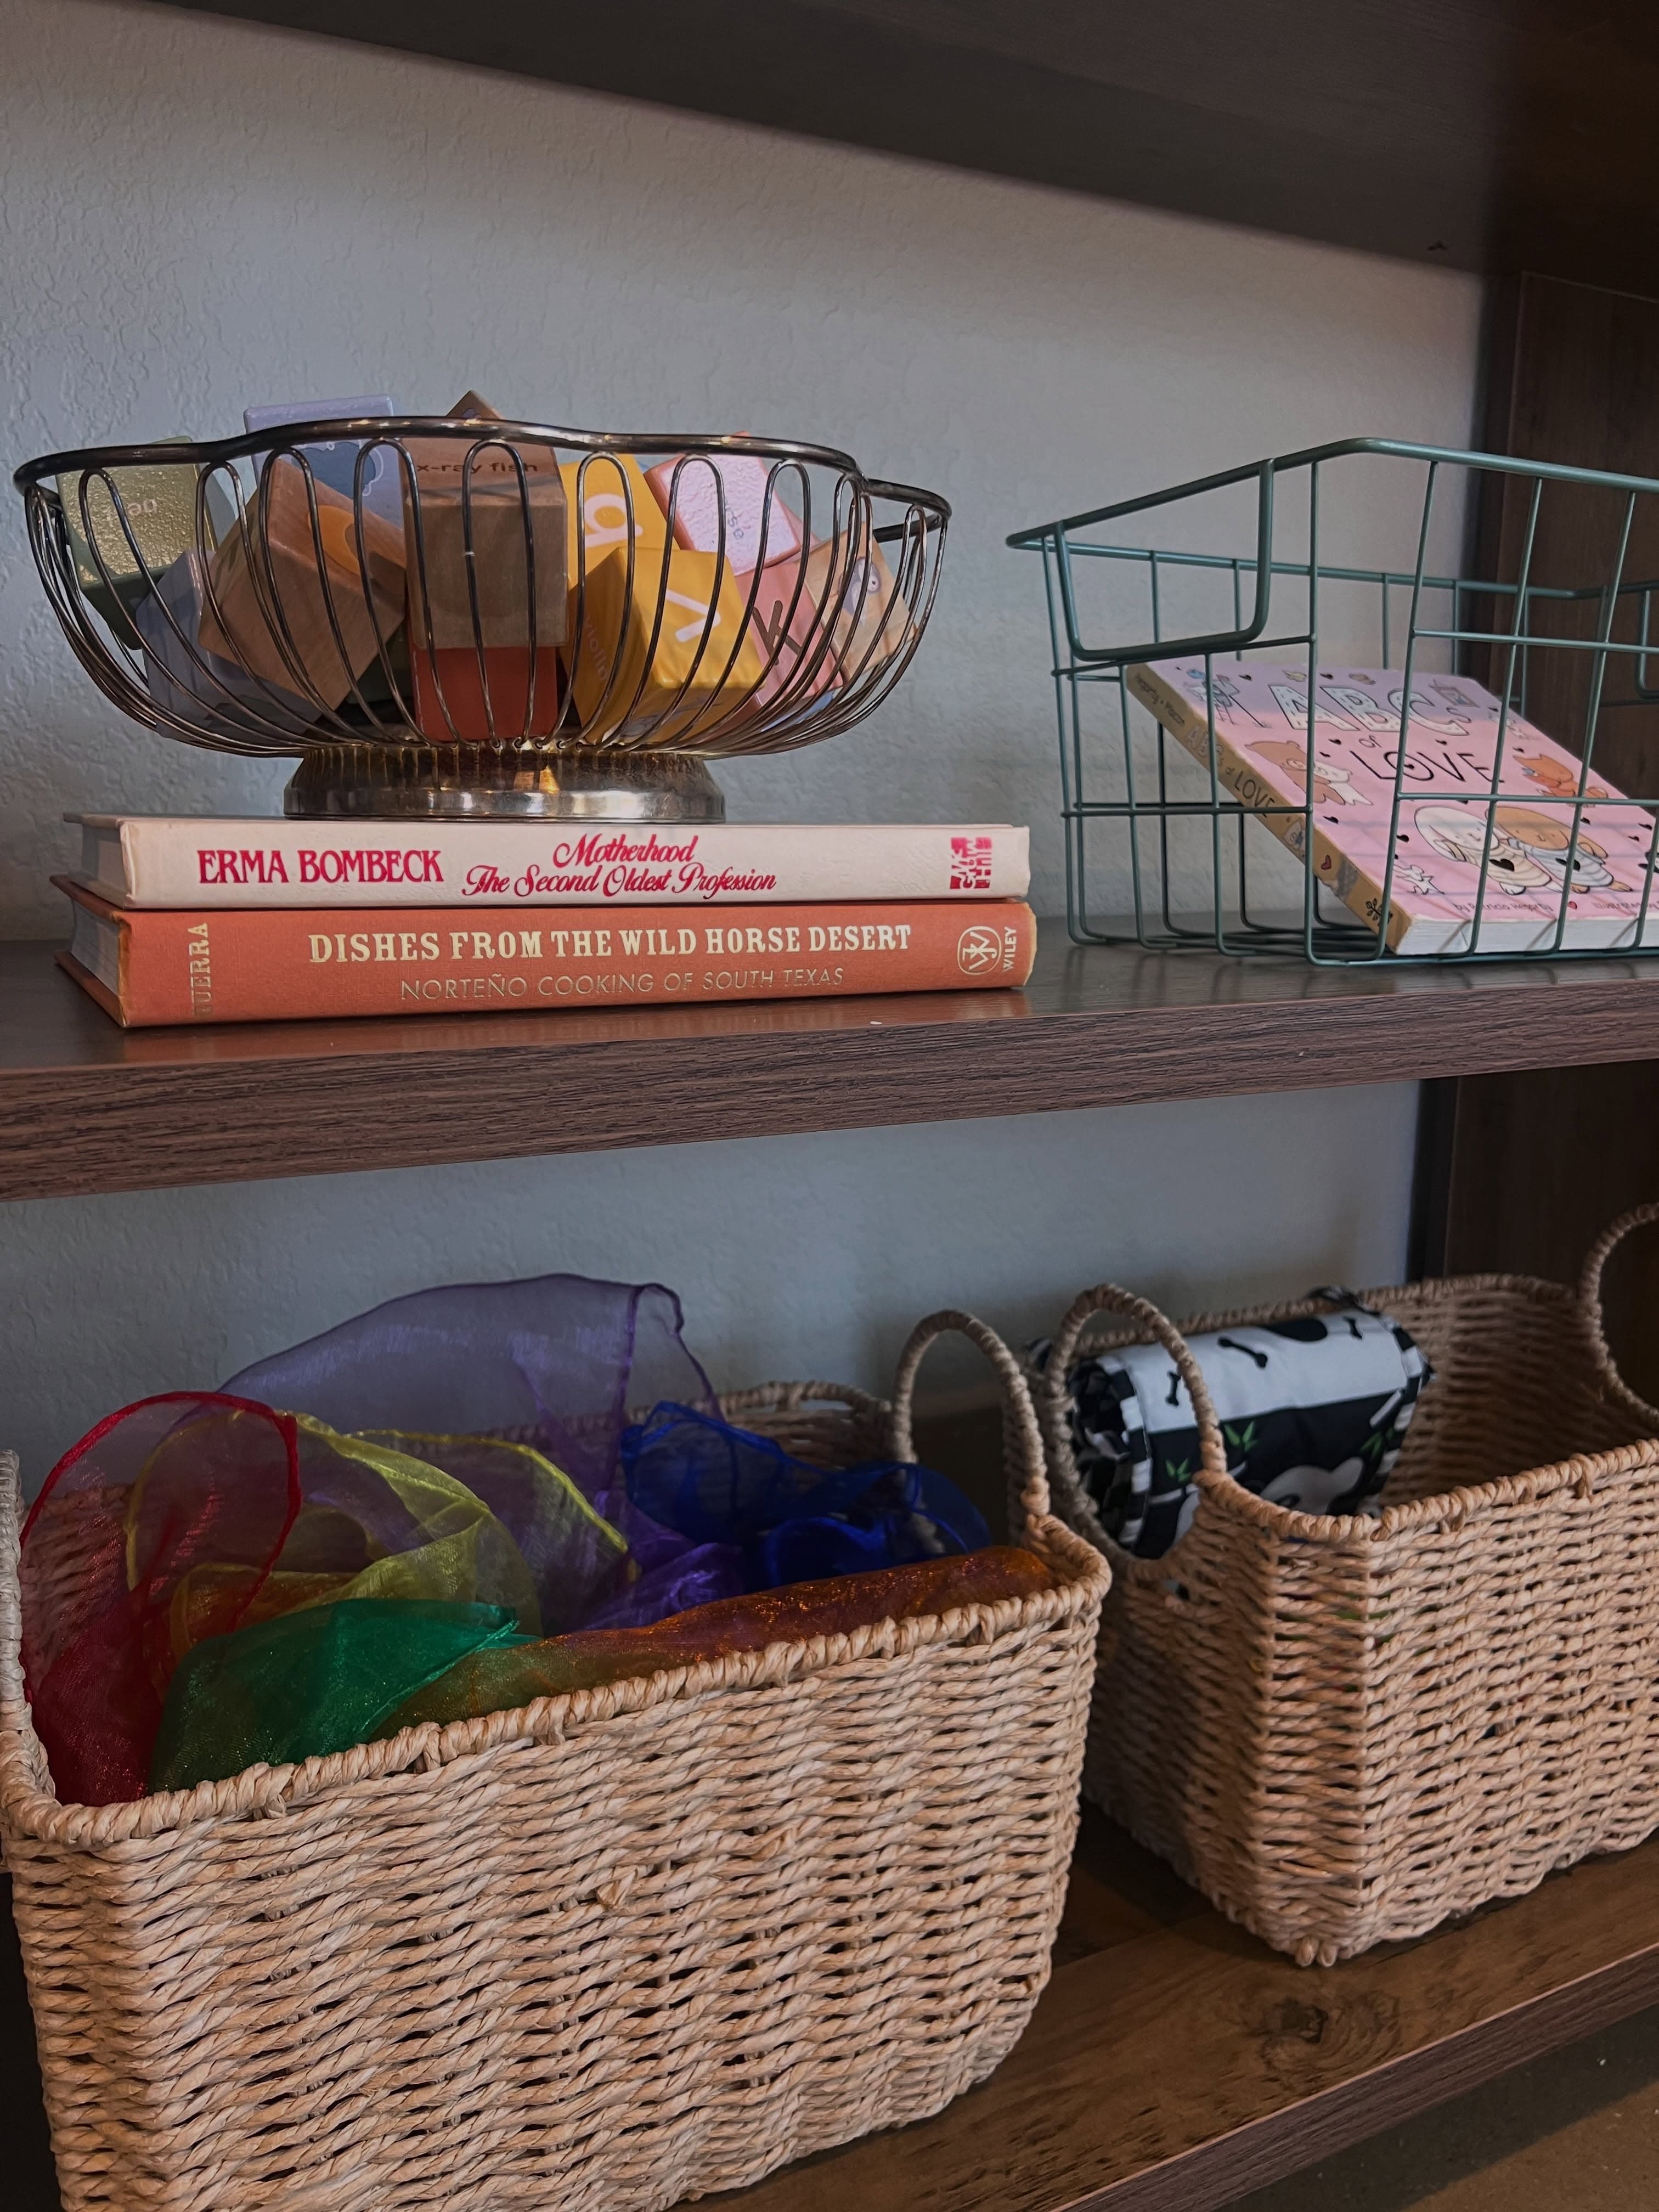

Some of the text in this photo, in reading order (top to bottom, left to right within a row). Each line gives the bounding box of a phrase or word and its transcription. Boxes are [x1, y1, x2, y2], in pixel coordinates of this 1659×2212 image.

[417, 462, 539, 475] x-ray fish
[1267, 684, 1471, 736] ABCs
[1358, 734, 1382, 748] of
[1349, 750, 1505, 782] LOVE
[197, 849, 445, 884] ERMA BOMBECK
[552, 832, 699, 868] Motherhood
[462, 862, 777, 900] The Second Oldest Profession
[308, 924, 912, 963] DISHES FROM THE WILD HORSE DESERT
[1002, 926, 1017, 972] WILEY
[401, 967, 844, 1000] NORTEÑO COOKING OF SOUTH TEXAS
